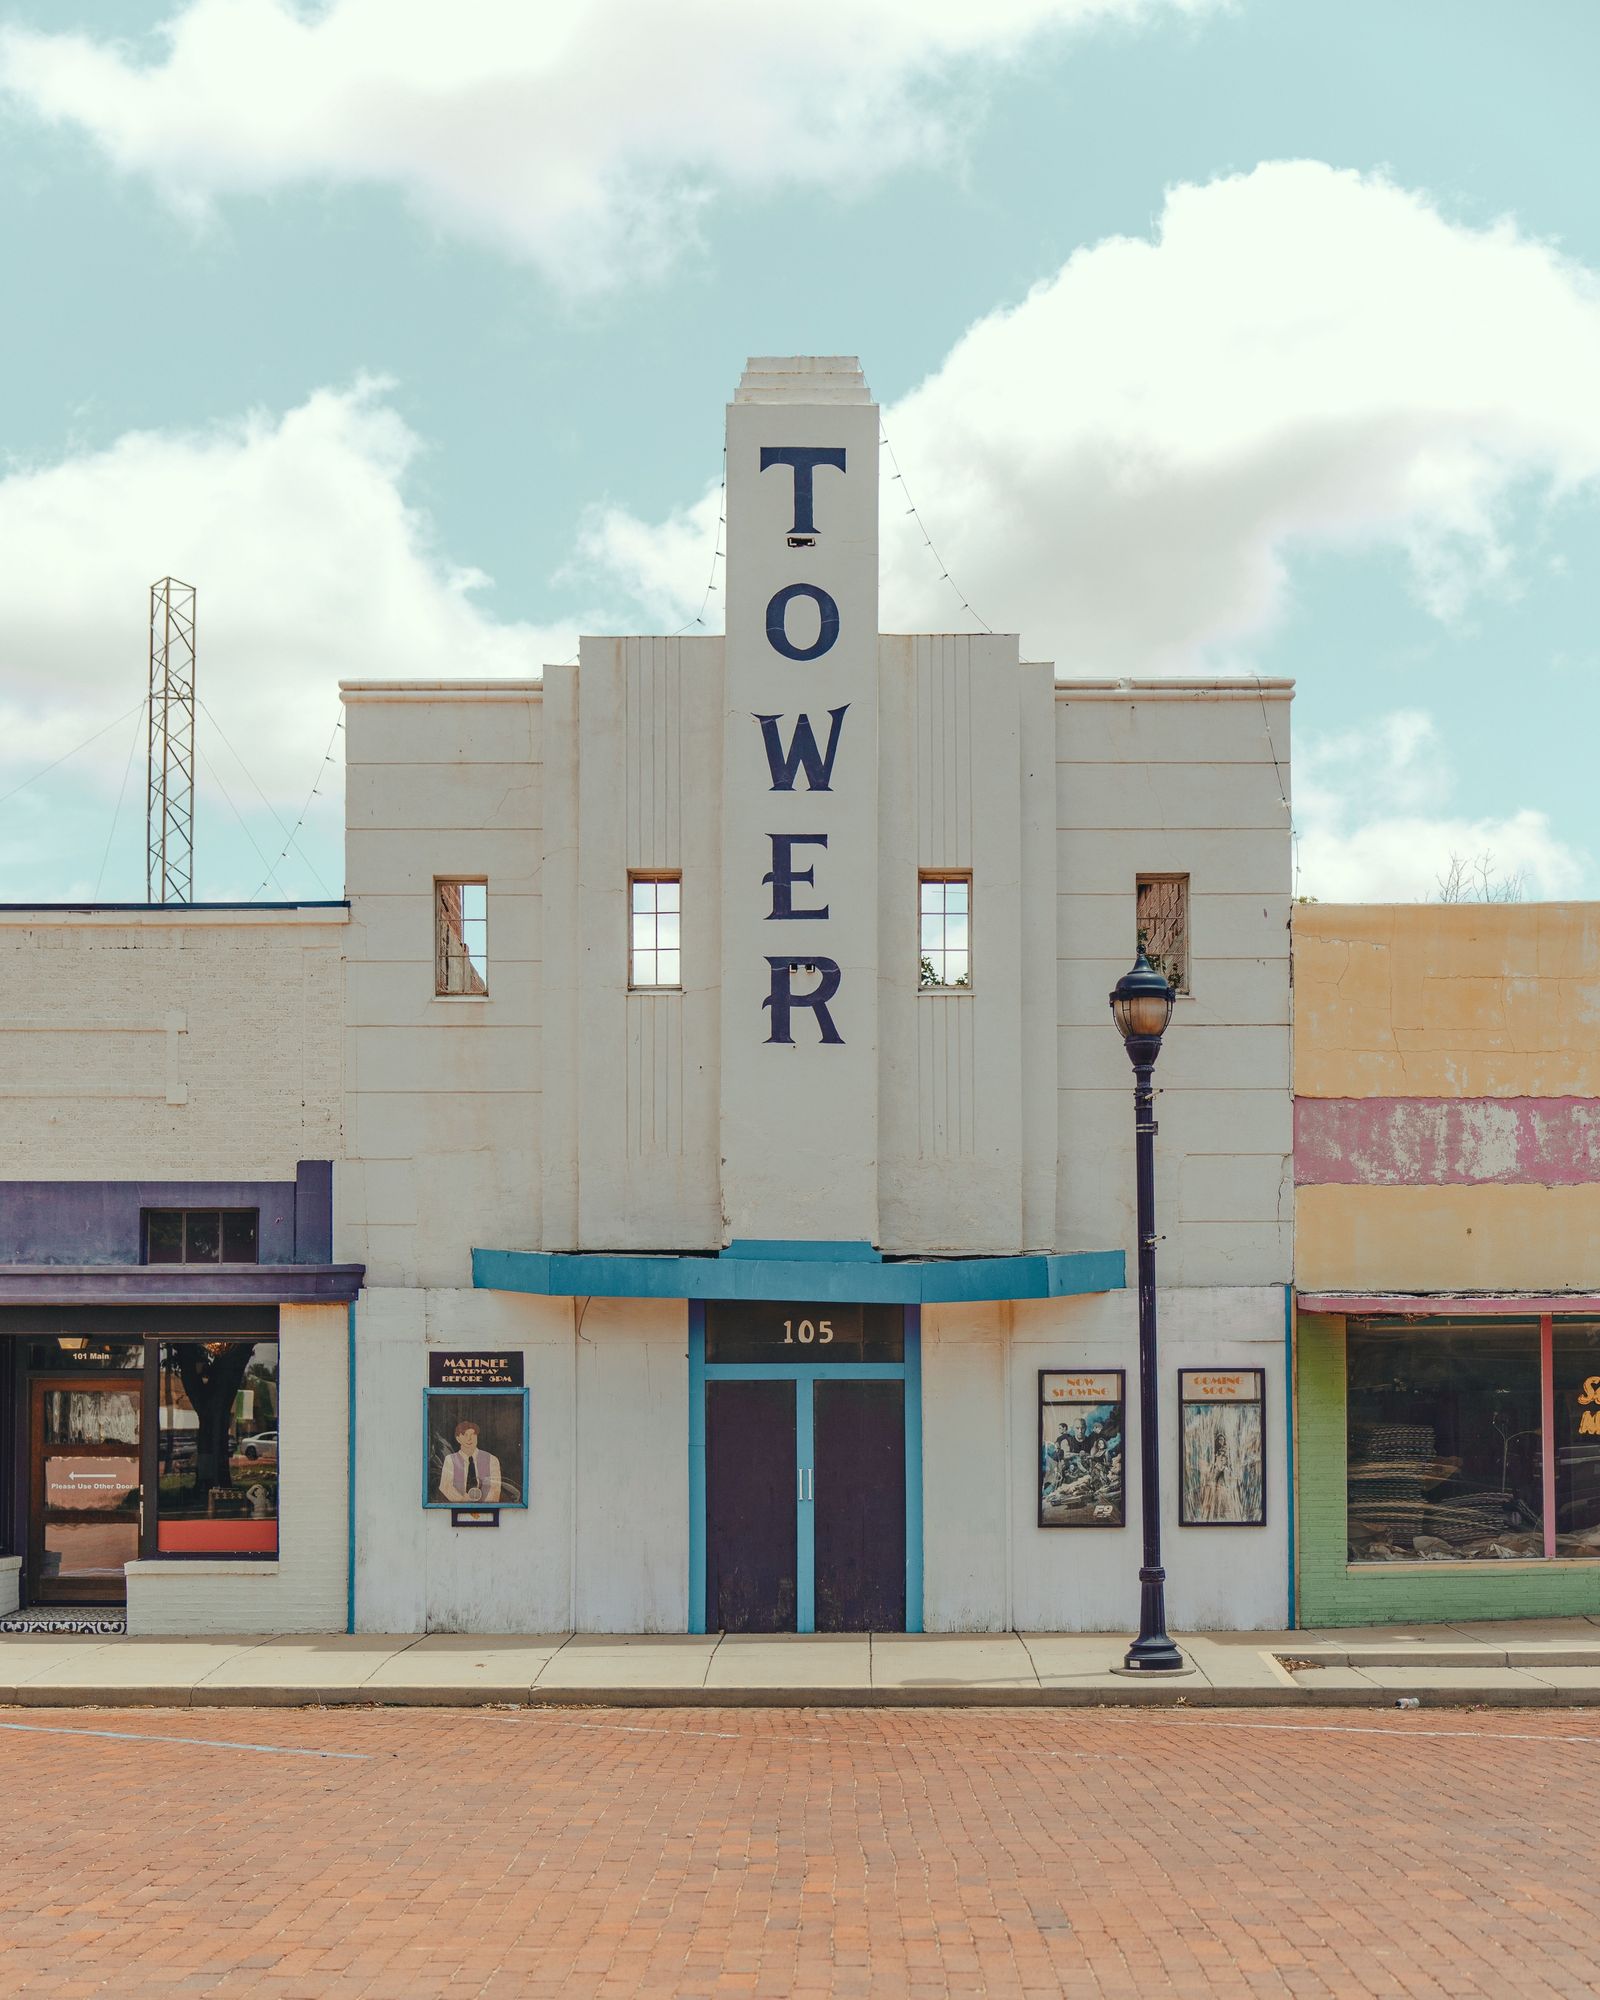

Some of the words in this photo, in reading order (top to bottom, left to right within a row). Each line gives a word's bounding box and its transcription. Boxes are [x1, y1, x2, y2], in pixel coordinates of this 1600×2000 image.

[750, 447, 852, 1045] TOWER
[783, 1320, 834, 1343] 105
[72, 1352, 88, 1360] 101
[89, 1352, 110, 1360] Main
[443, 1358, 509, 1368] MATINEE
[441, 1375, 483, 1383] BEFORE
[1066, 1378, 1096, 1386] NOW
[1192, 1376, 1245, 1385] COMING
[1051, 1388, 1110, 1397] SHOWING
[1201, 1387, 1237, 1395] SOON
[1092, 1505, 1113, 1516] F9
